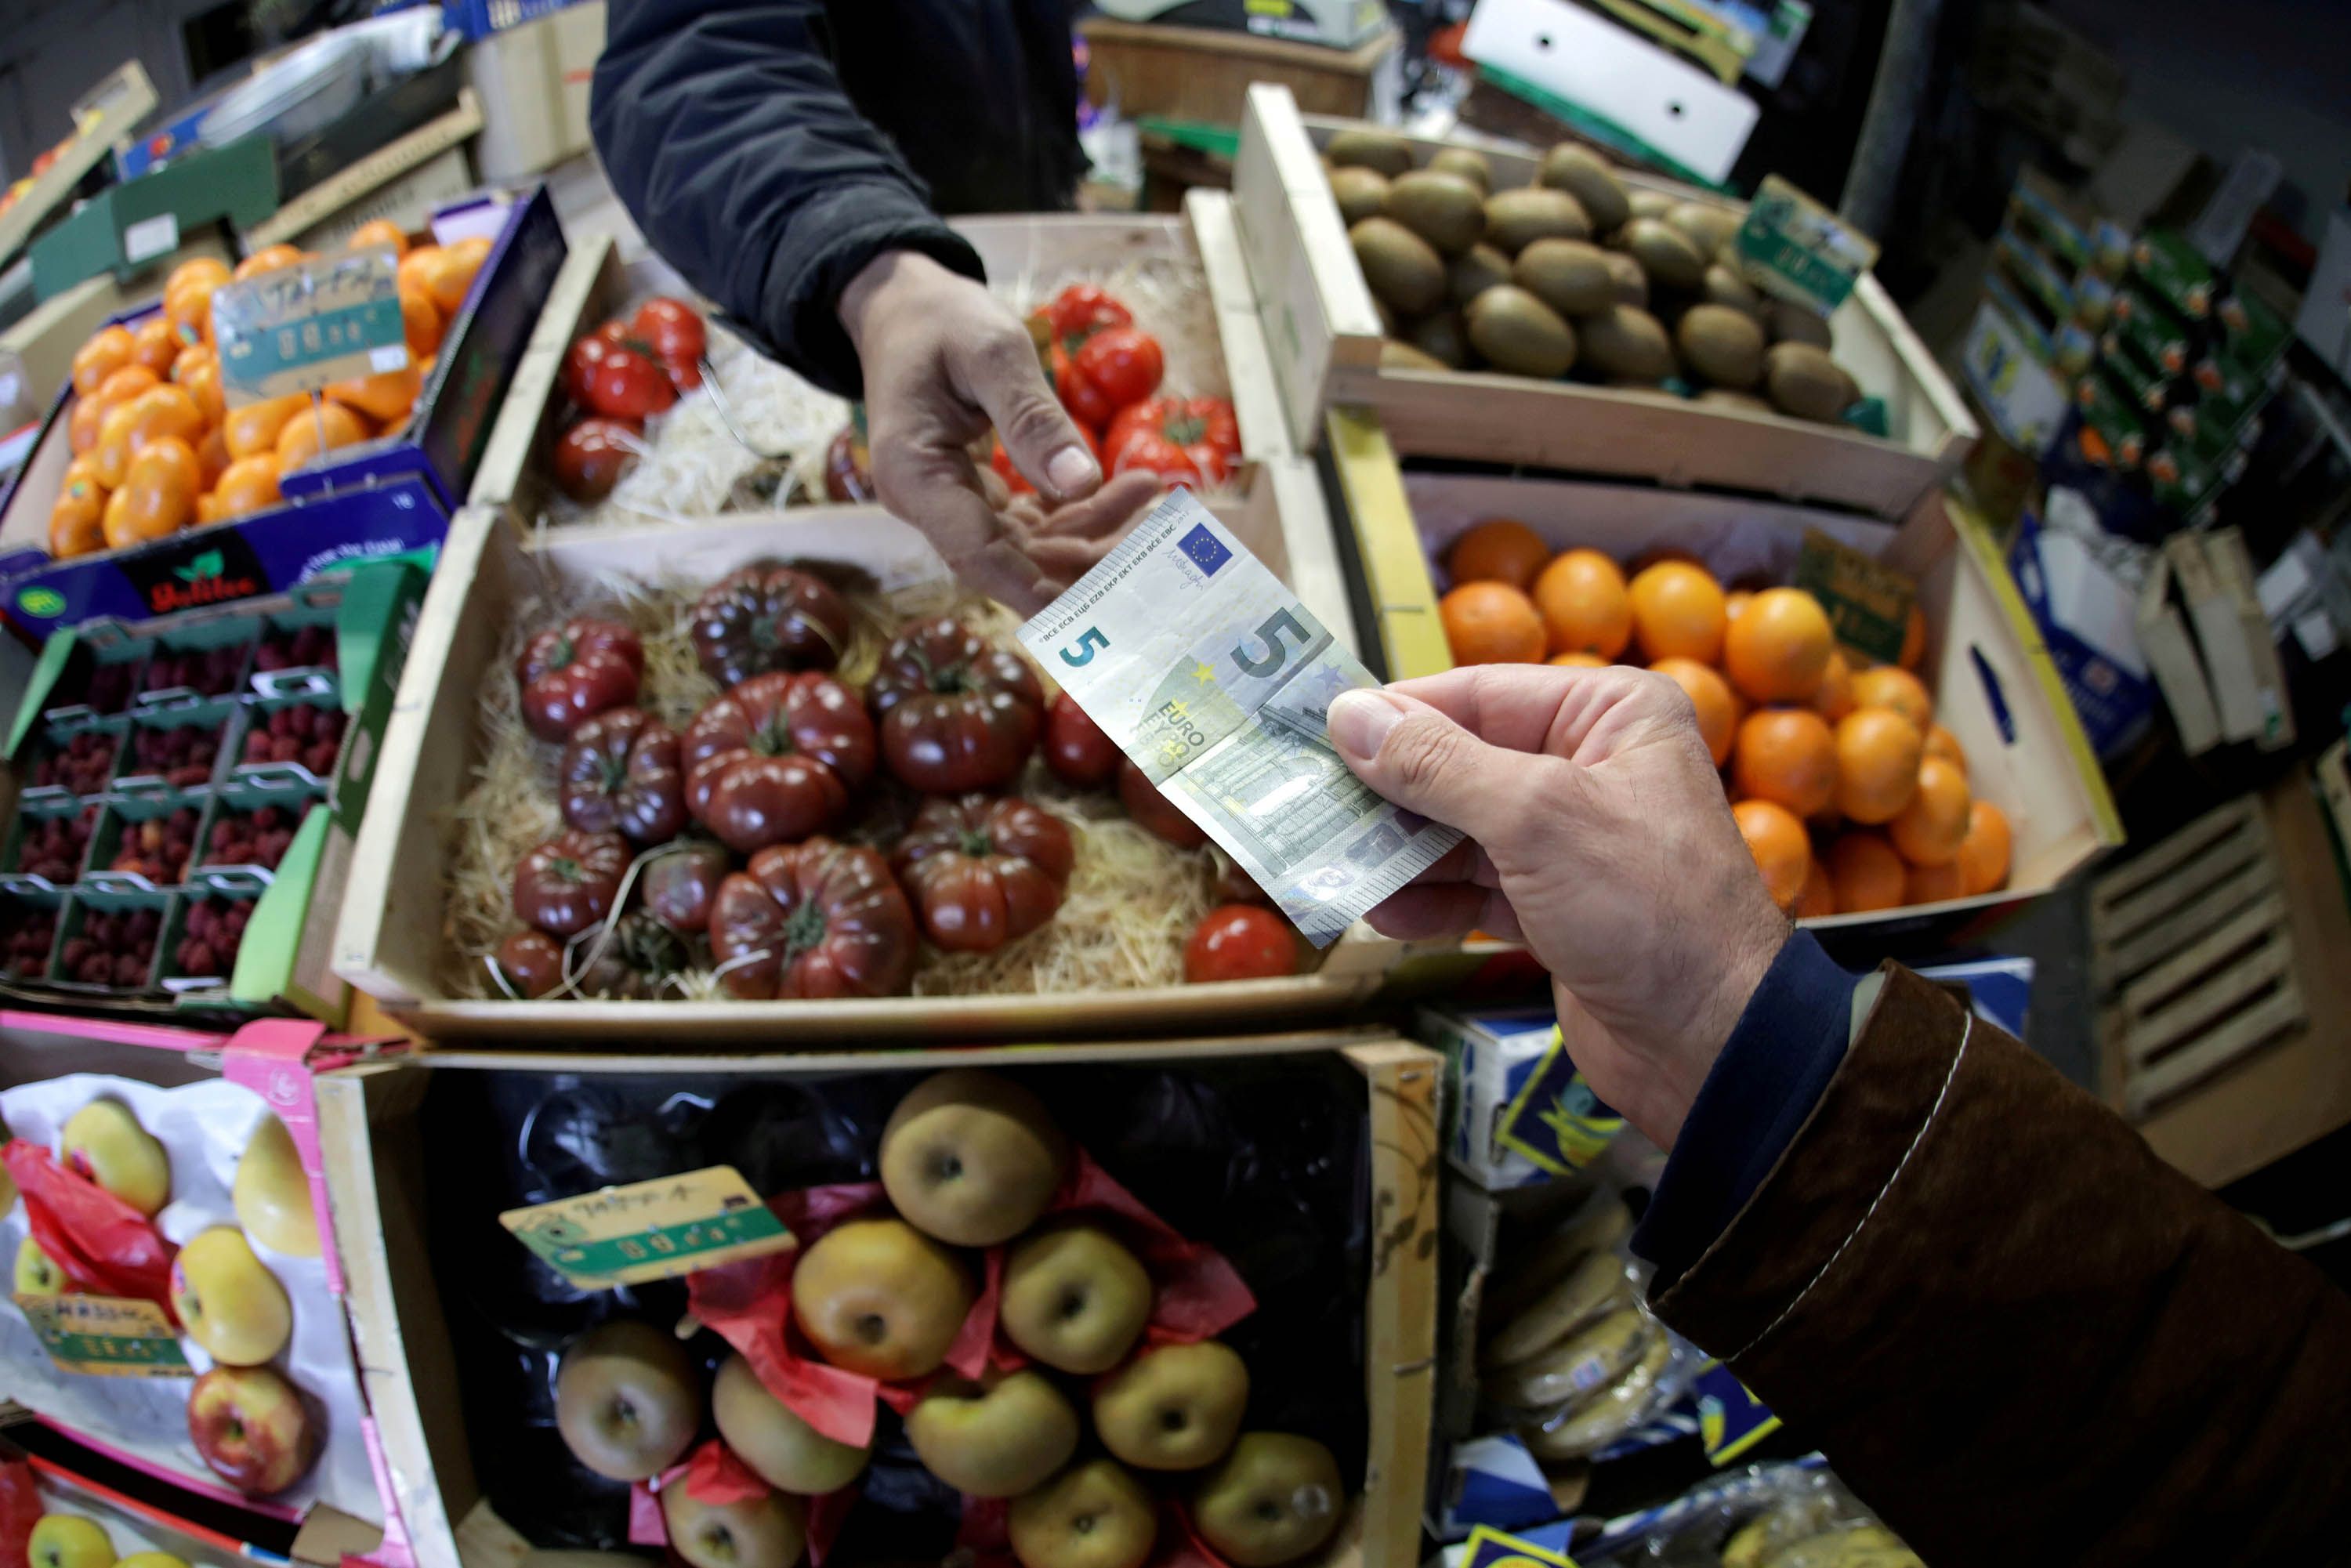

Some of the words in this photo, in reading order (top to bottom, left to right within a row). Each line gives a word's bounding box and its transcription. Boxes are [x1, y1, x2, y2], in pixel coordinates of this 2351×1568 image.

[1058, 616, 1074, 629] ECB
[1089, 590, 1104, 604] EZB
[1103, 578, 1118, 592] EKP
[1132, 551, 1147, 566] EKB
[1161, 524, 1176, 539] EBC
[1059, 625, 1110, 668] 5
[1230, 607, 1311, 678] 5
[1158, 701, 1204, 746] EURO
